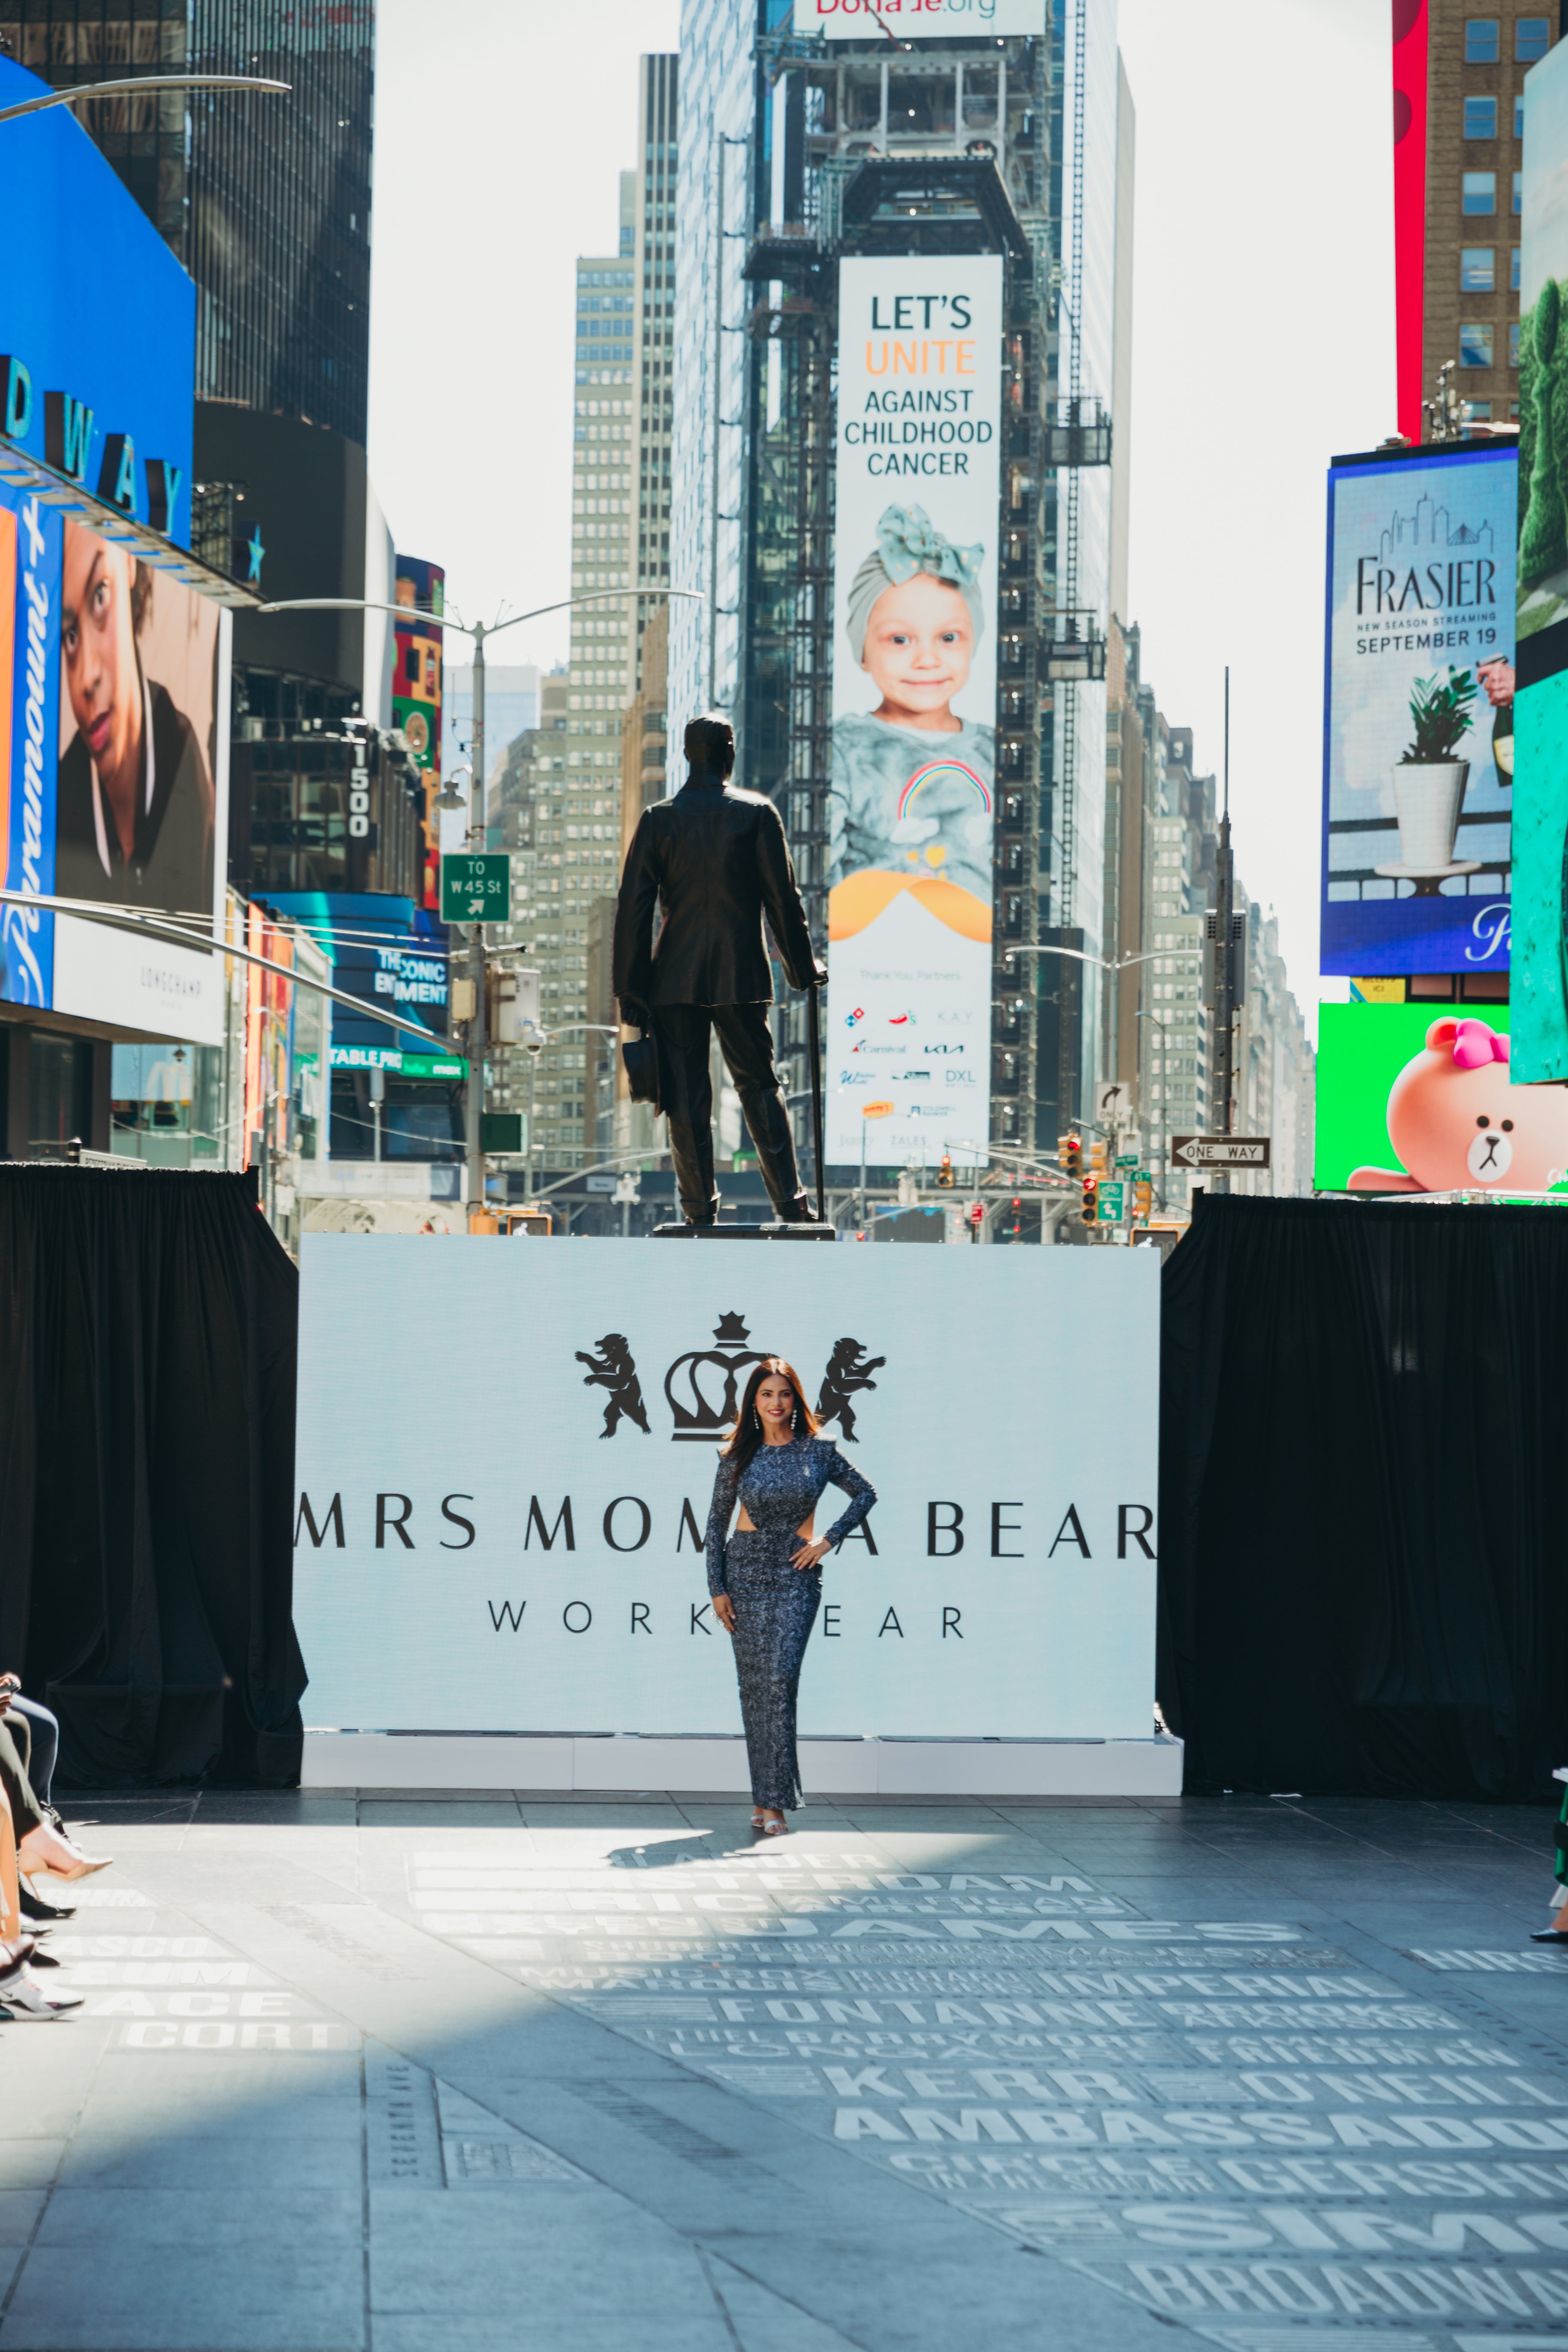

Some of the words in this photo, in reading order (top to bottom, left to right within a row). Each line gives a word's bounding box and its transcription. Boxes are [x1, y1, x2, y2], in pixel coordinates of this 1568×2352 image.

[872, 295, 972, 330] LET'S
[866, 340, 976, 375] UNITE
[864, 389, 974, 413] AGAINST
[844, 421, 992, 444] CHILDHOOD
[867, 453, 969, 475] CANCER
[1357, 557, 1496, 615] FRASIER
[1357, 622, 1380, 632] NEW
[1385, 619, 1428, 630] SEASON
[1433, 612, 1497, 626] STREAMING
[1357, 630, 1469, 654] SEPTEMBER
[1477, 628, 1497, 644] 19
[349, 744, 369, 838] 1500
[469, 862, 485, 874] TO
[451, 881, 461, 893] W
[465, 880, 484, 894] 45
[488, 880, 501, 894] St
[946, 1070, 975, 1082] DXL
[1186, 1146, 1214, 1158] ONE
[1228, 1147, 1257, 1159] WAY
[293, 1491, 475, 1550] MRS
[524, 1494, 879, 1556] MOMA
[927, 1501, 1158, 1560] BEAR
[487, 1600, 964, 1639] WORKEAR
[788, 1896, 1116, 1906] AMERICAN
[793, 1905, 1126, 1914] AIRLINES
[583, 1940, 764, 1952] SHUBERT
[585, 1951, 842, 1963] BOOTH
[519, 1966, 705, 1978] MUSIC
[720, 1969, 834, 1980] BOX
[1409, 1948, 1568, 1974] HIRS
[538, 1978, 843, 1991] MARQUIS
[1037, 1974, 1405, 1998] IMPERIAL
[717, 1999, 1158, 2027] FONTANNE
[1157, 2003, 1436, 2018] BROOKS
[126, 2021, 342, 2049] CORT
[1184, 2016, 1462, 2030] ATKINSON
[1194, 2046, 1522, 2067] FRIEDMAN
[821, 2066, 1142, 2102] KERR
[1239, 2072, 1568, 2106] O'NEILL
[833, 2106, 1568, 2150] AMBASSADO
[889, 2153, 1205, 2177] CIRCLE
[1128, 2262, 1568, 2318] BROADWA
